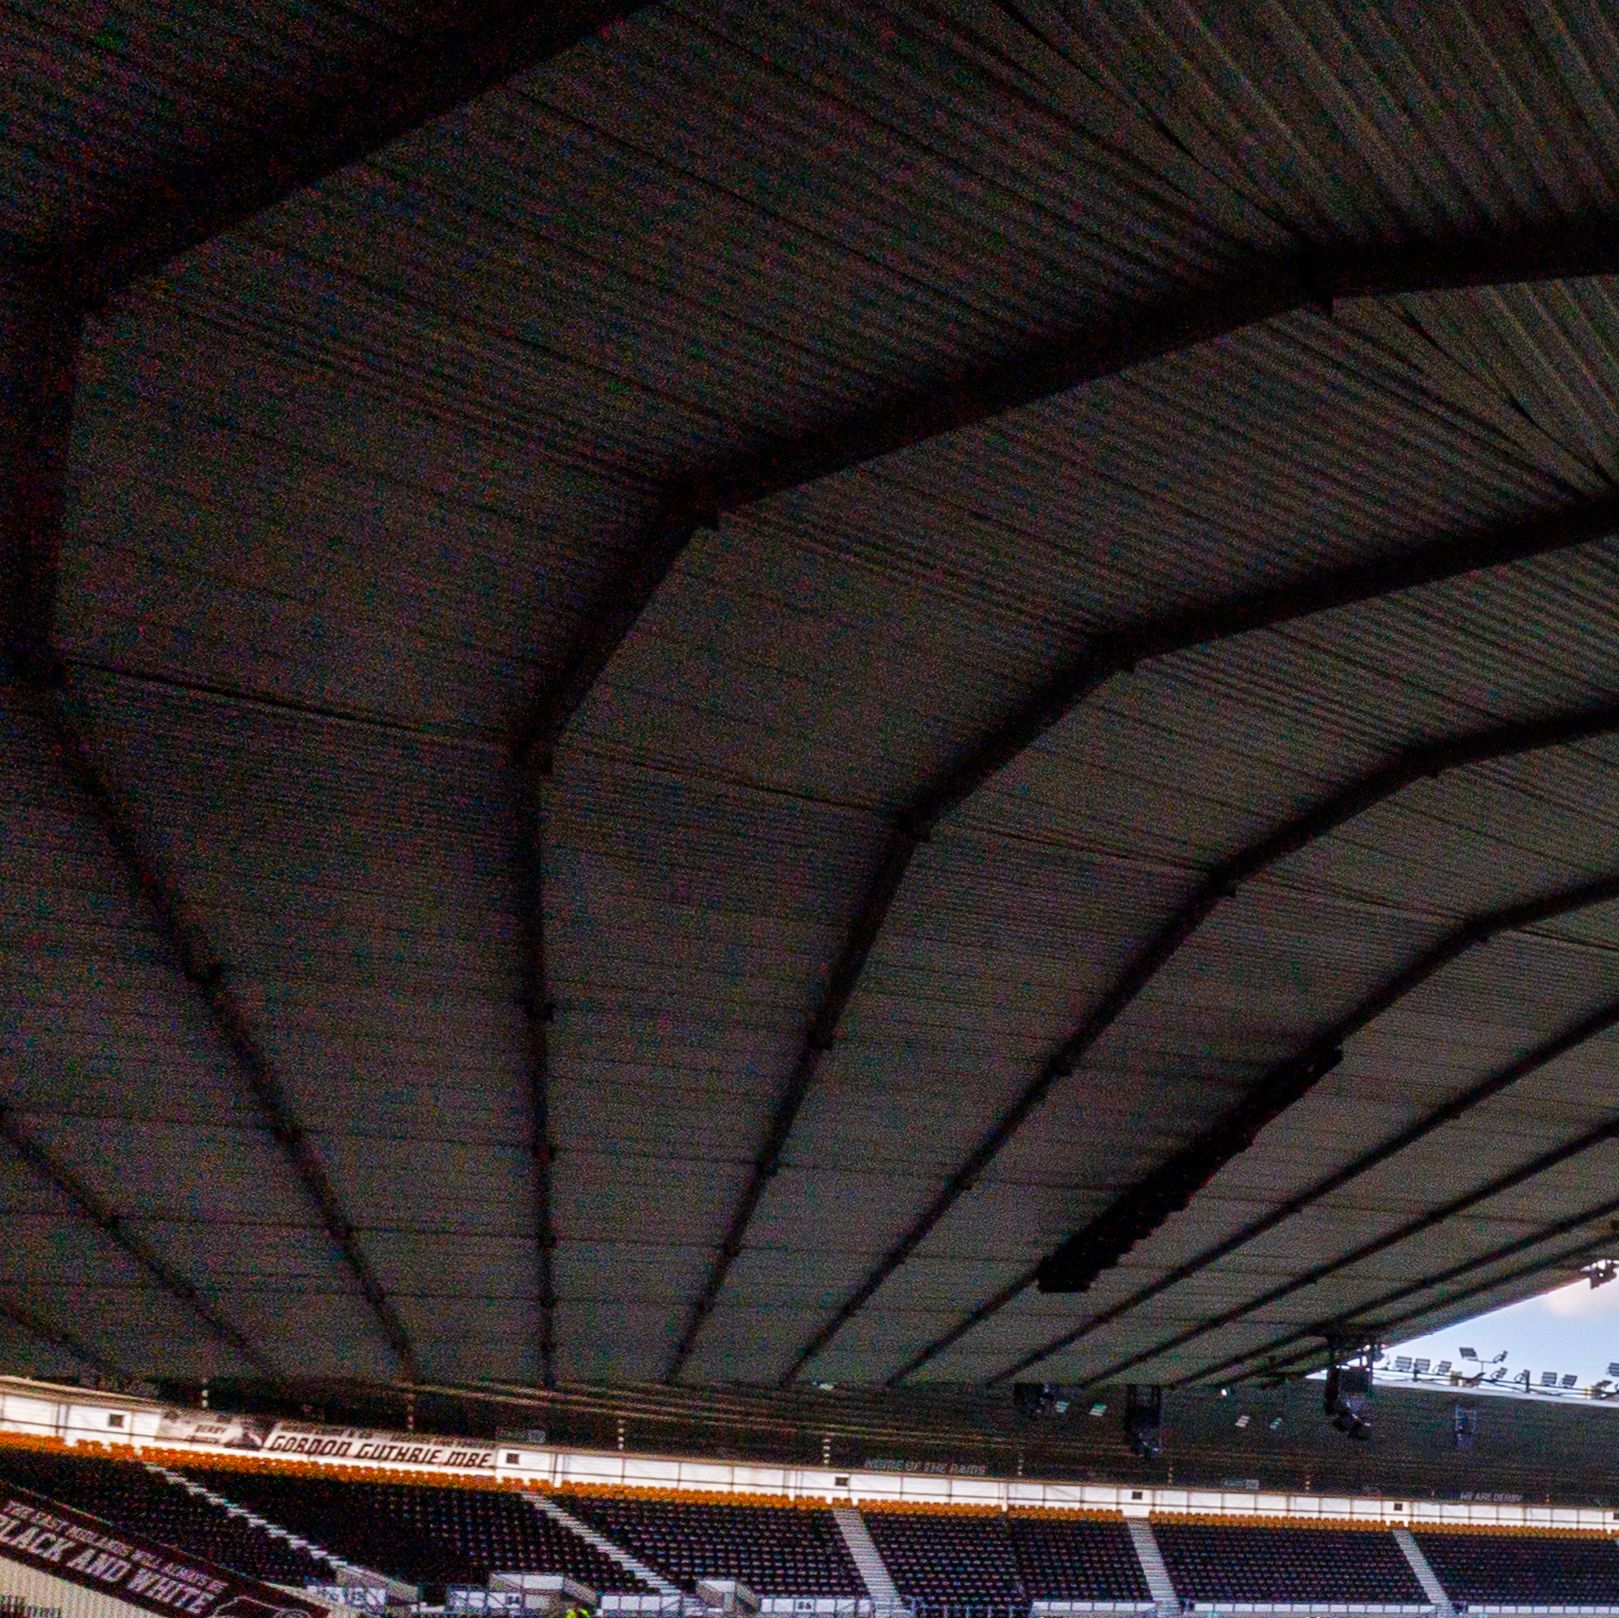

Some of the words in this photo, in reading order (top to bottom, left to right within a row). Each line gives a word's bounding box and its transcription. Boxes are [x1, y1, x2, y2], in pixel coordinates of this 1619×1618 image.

[269, 1435, 353, 1457] GORDON
[353, 1443, 444, 1465] GUTHRIE
[443, 1450, 493, 1468] MBE
[65, 1548, 132, 1584] AND
[125, 1566, 218, 1616] WHITE
